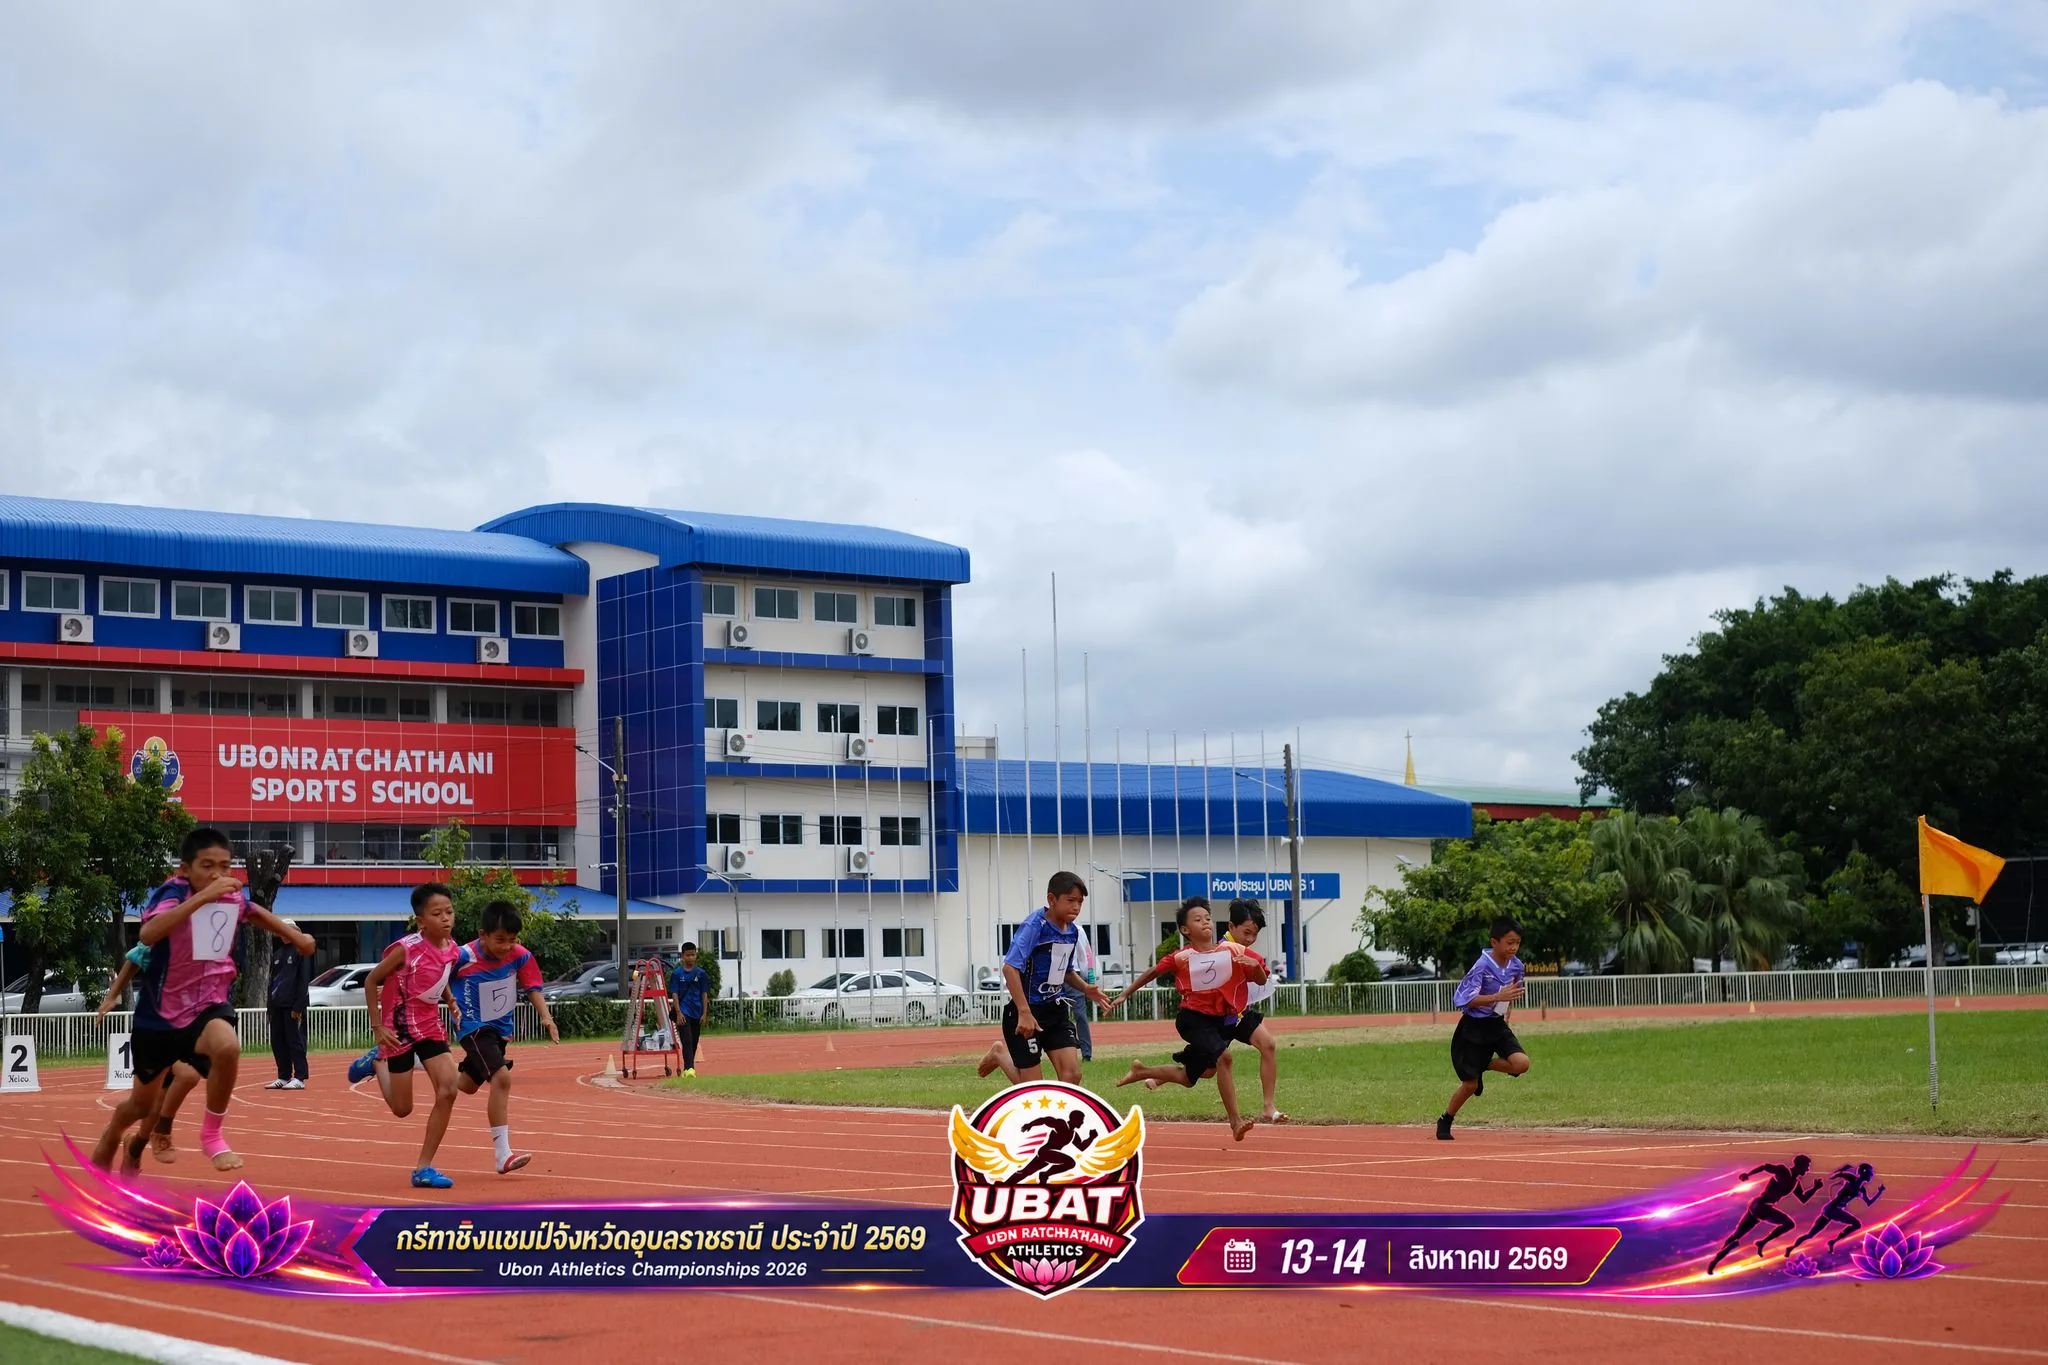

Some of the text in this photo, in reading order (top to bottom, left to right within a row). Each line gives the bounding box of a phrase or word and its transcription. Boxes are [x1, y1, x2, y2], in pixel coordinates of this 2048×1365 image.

[218, 743, 494, 775] UBONRATCHATHANI
[251, 777, 474, 805] SPORTS SCHOOL
[1309, 879, 1315, 892] 1
[210, 910, 229, 953] 8
[1200, 960, 1217, 985] 3
[492, 986, 508, 1013] 5
[10, 1044, 29, 1073] 2
[118, 1041, 130, 1070] 1
[1027, 1038, 1039, 1054] 5
